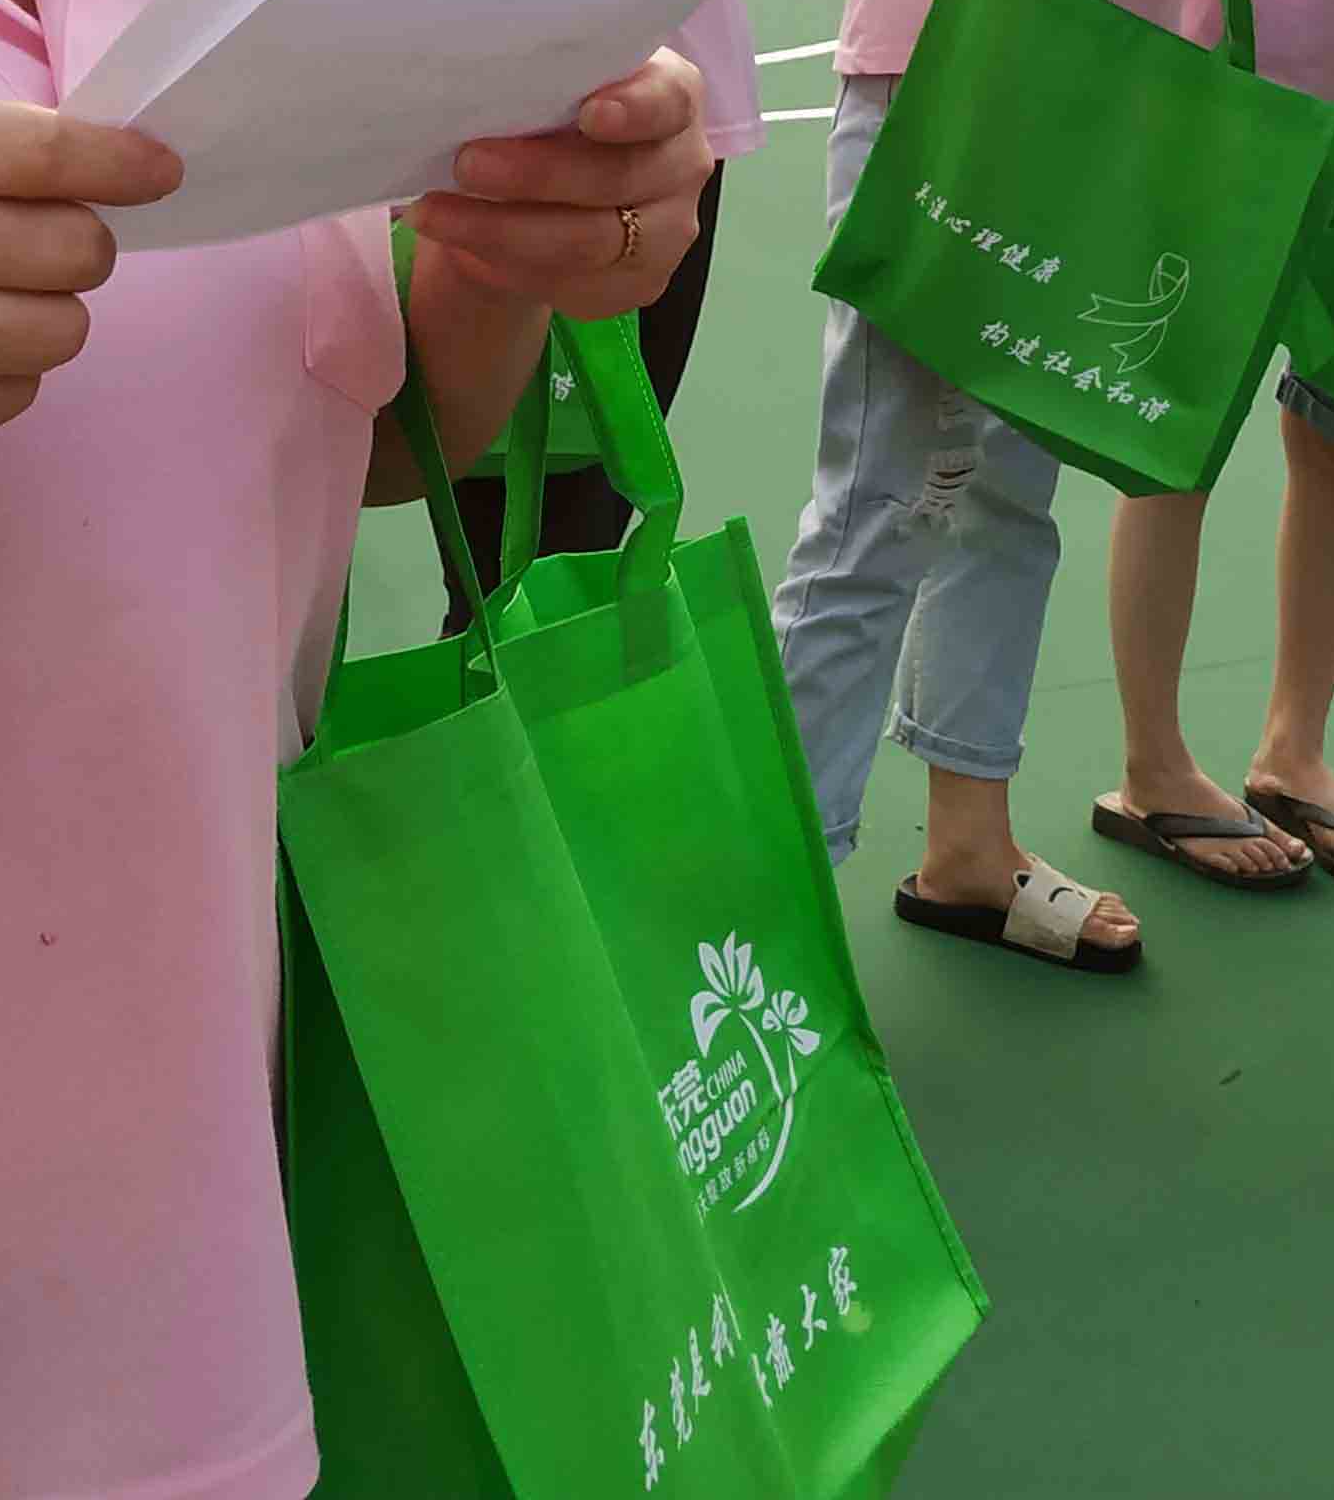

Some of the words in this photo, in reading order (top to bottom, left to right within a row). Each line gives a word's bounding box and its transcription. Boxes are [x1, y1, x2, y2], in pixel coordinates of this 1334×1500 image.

[914, 180, 1063, 284] 关注心理健康
[979, 320, 1172, 424] 构建社会和谐
[706, 1049, 748, 1100] CHINA
